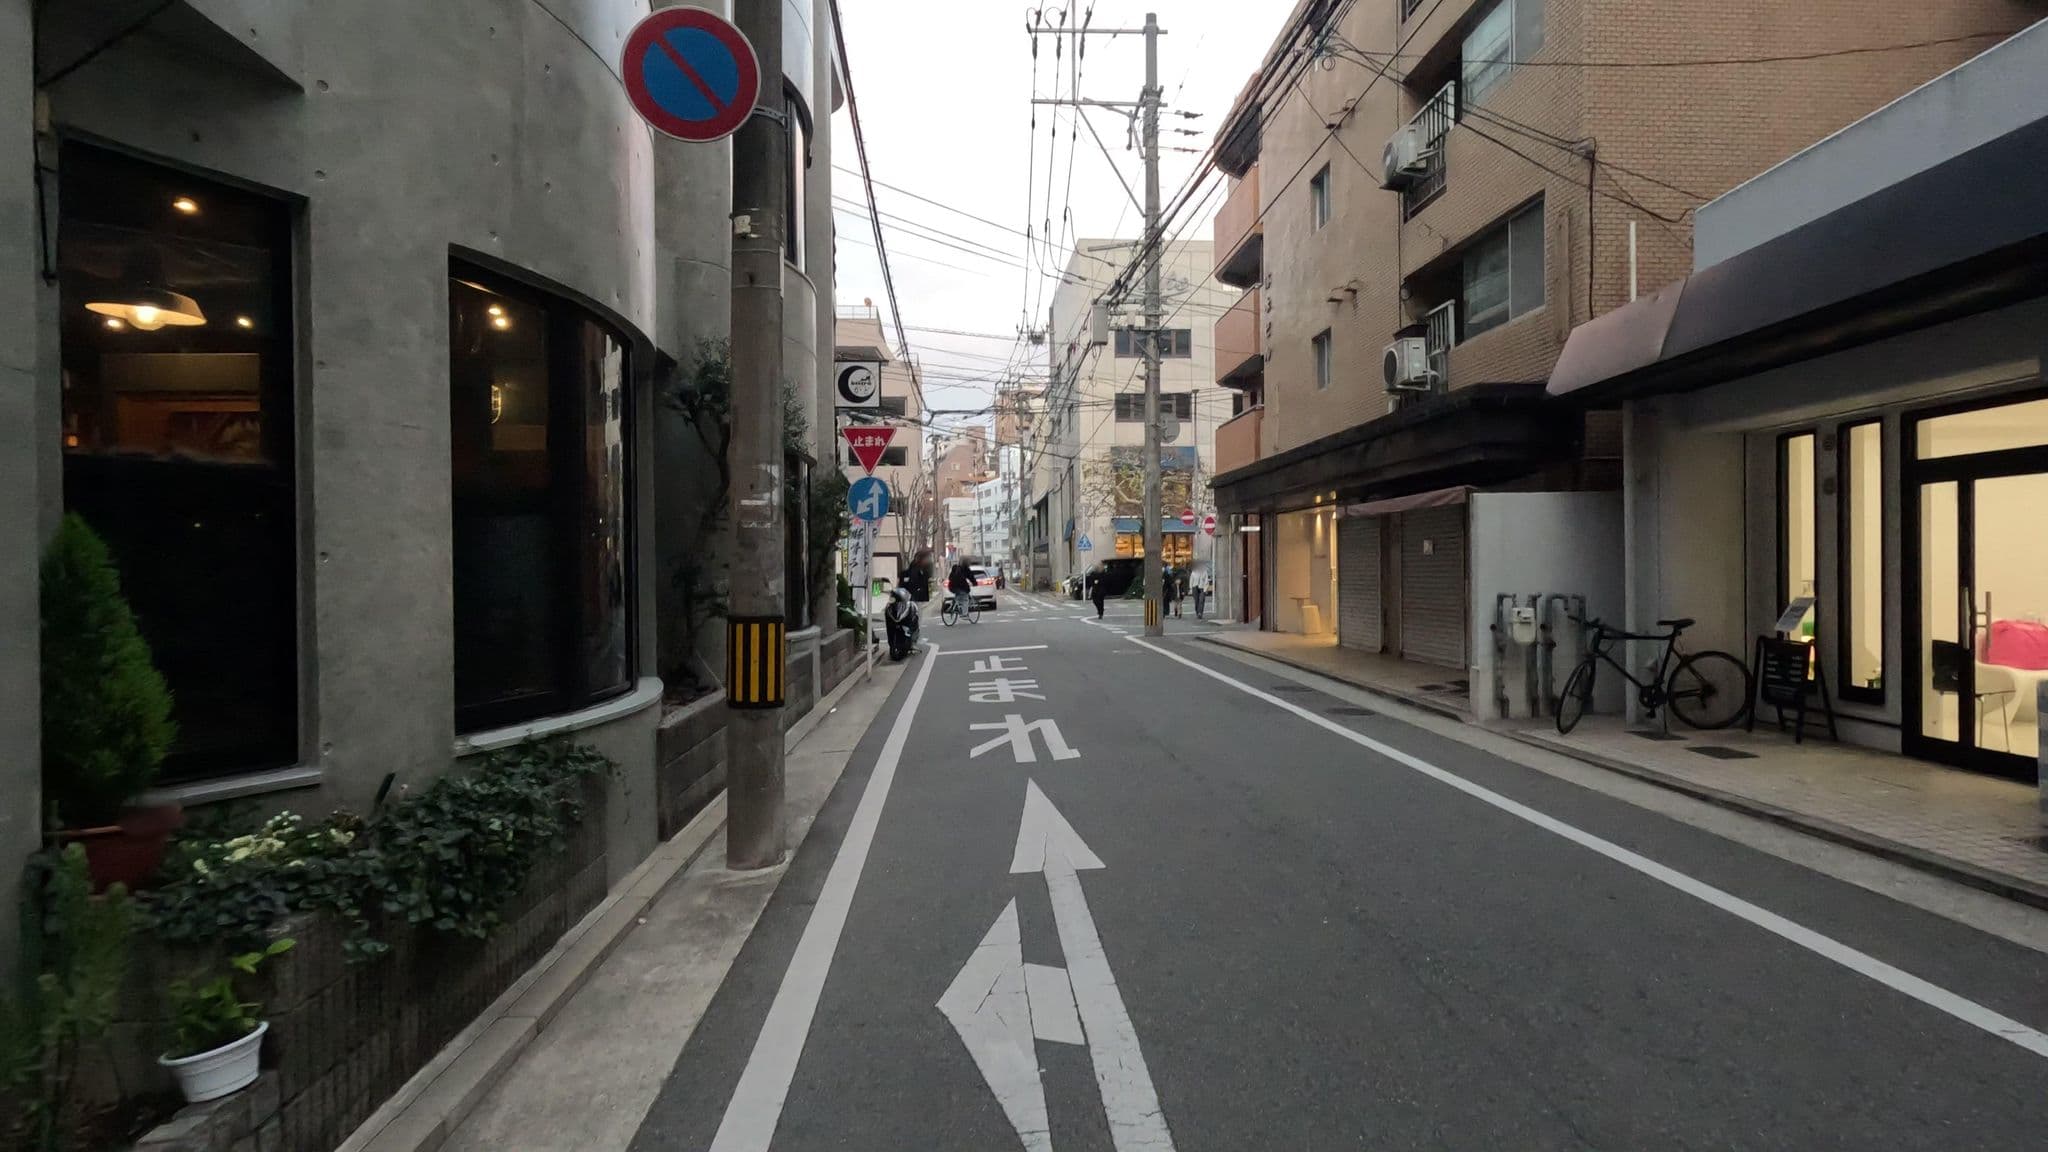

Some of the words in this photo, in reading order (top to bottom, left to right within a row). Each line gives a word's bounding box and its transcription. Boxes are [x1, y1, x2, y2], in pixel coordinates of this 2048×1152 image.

[853, 435, 886, 447] 止まれ
[968, 655, 1081, 763] 止まれ
